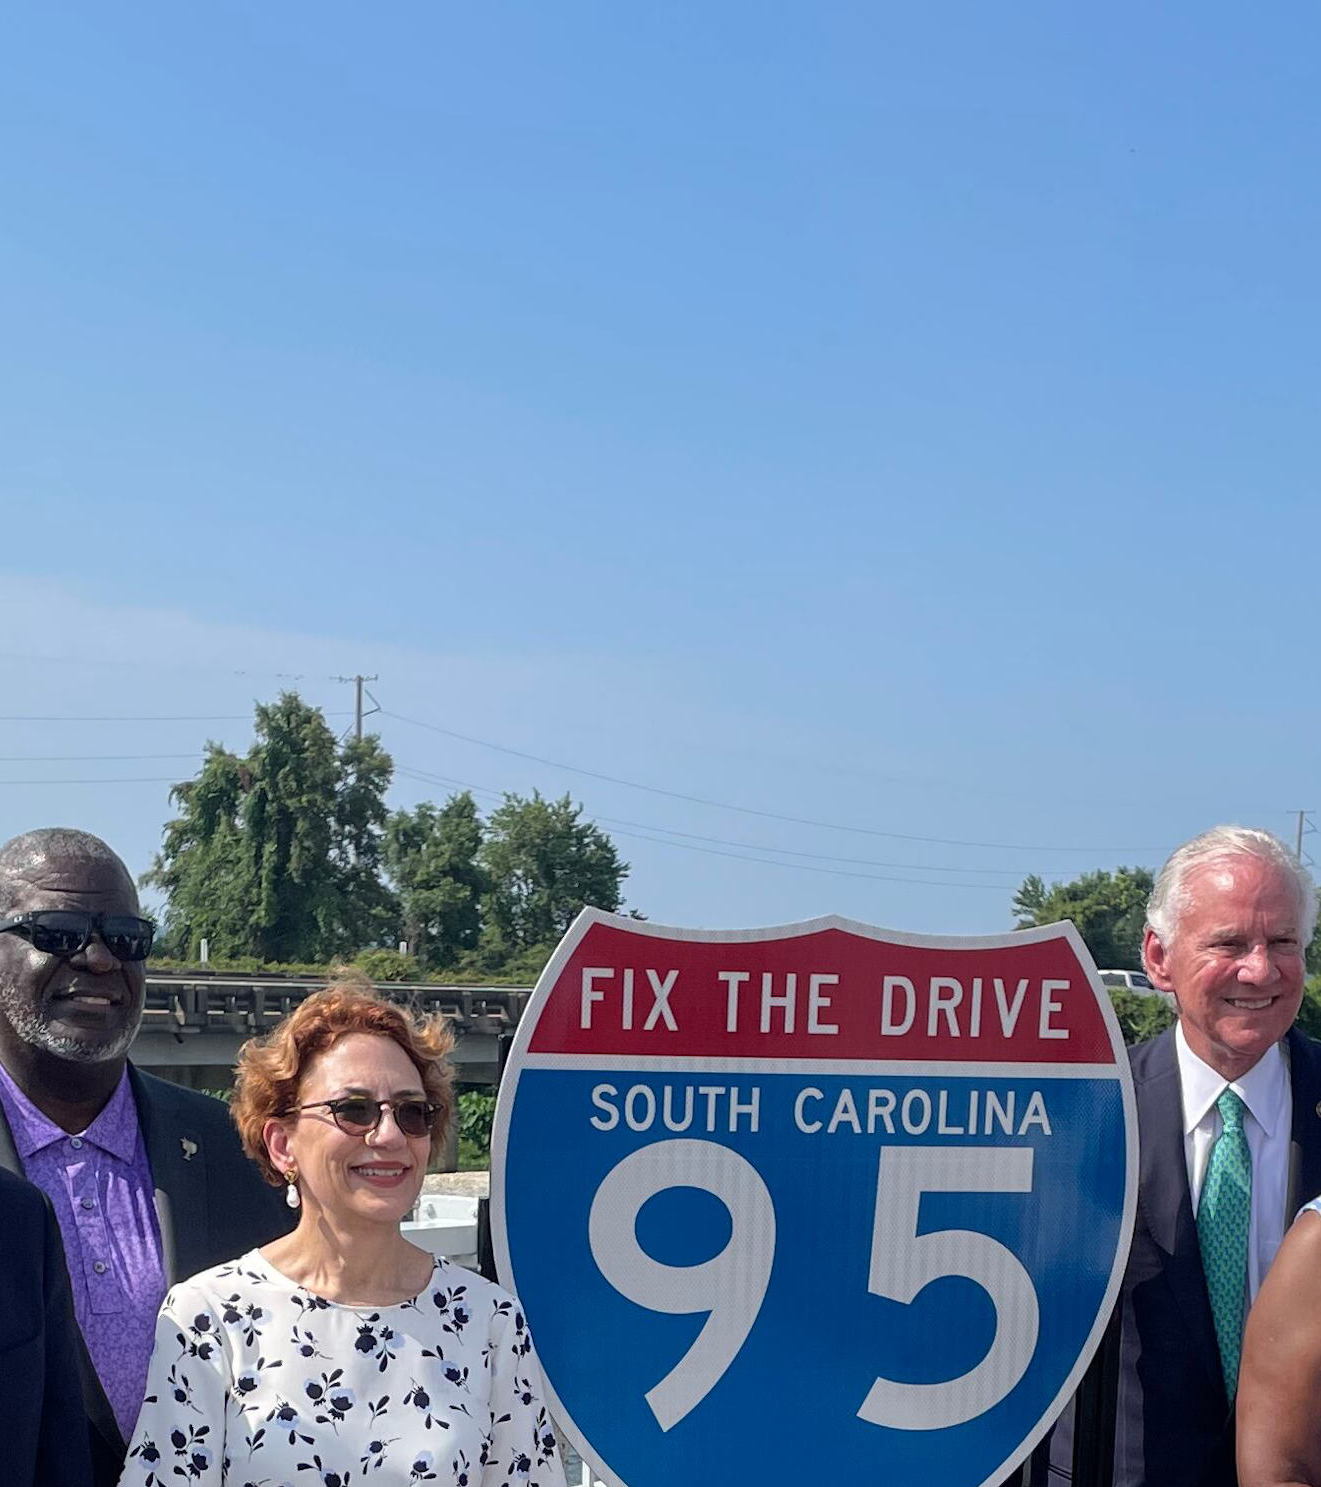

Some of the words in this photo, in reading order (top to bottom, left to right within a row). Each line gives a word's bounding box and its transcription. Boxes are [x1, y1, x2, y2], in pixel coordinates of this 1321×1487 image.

[581, 967, 679, 1032] FIX
[718, 971, 840, 1035] THE
[880, 975, 1071, 1040] DRIVE
[590, 1083, 760, 1133] SOUTH
[793, 1087, 1052, 1136] CAROLINA
